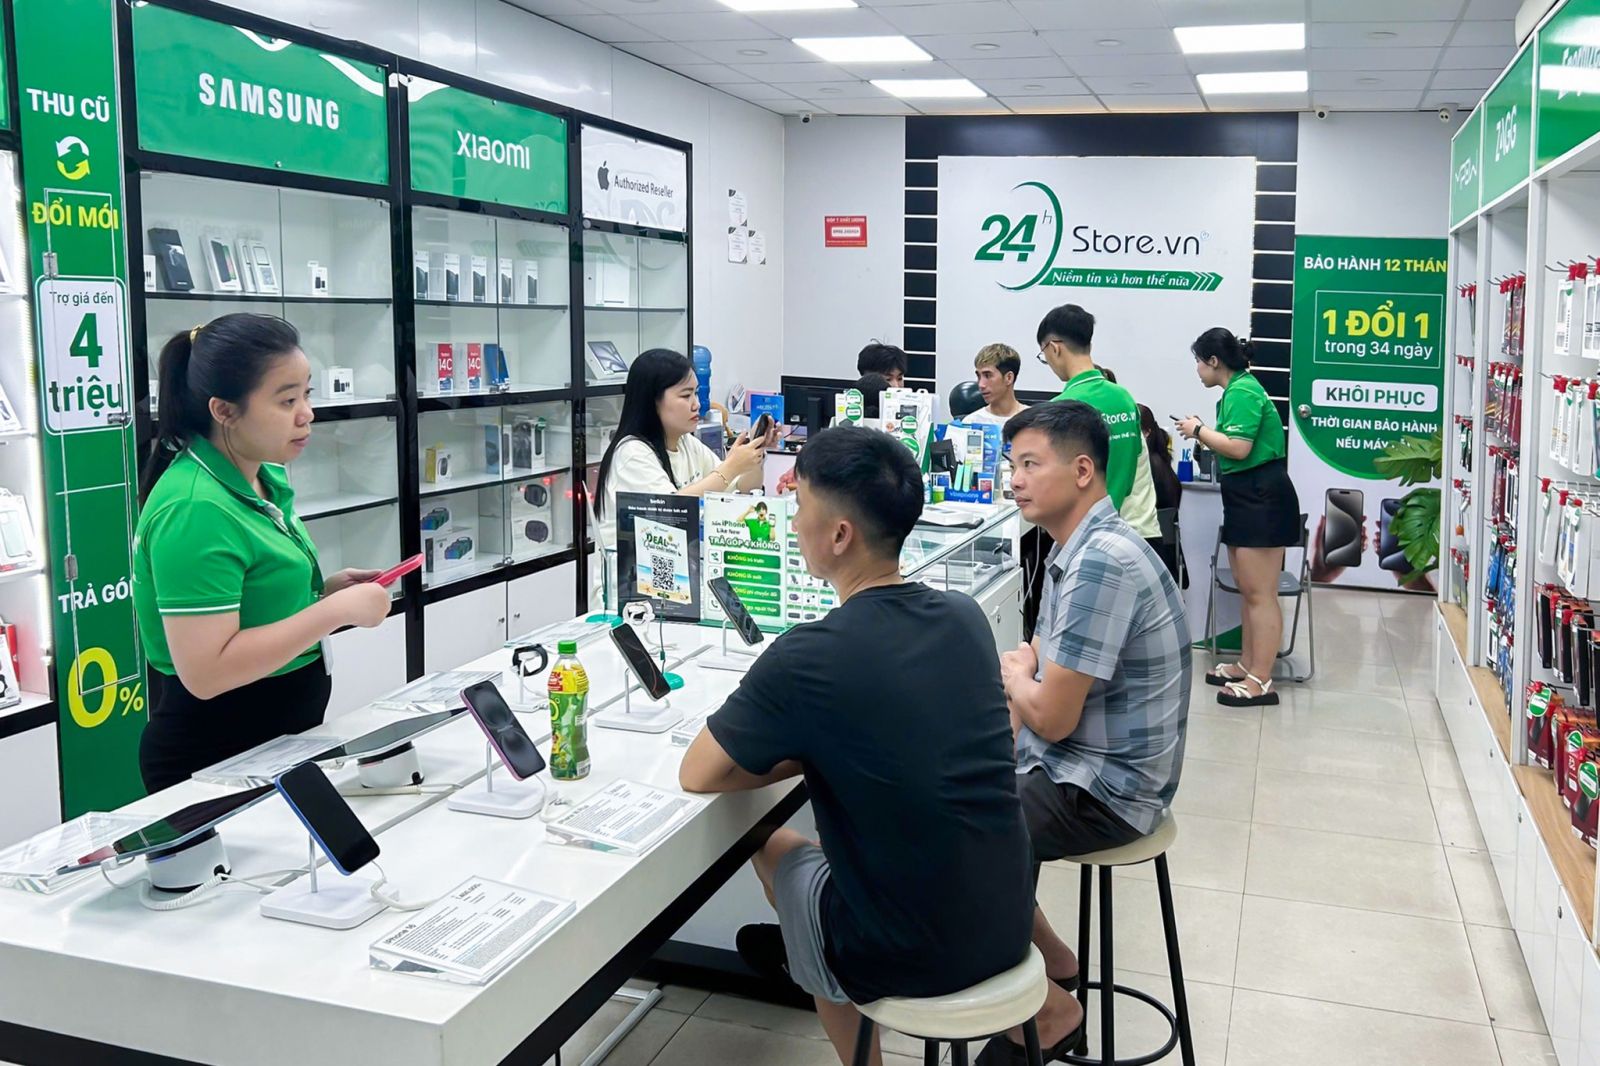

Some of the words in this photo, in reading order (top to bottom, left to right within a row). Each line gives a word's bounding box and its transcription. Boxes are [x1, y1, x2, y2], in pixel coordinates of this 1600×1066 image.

[26, 88, 74, 117] THU
[81, 95, 110, 122] CŨ
[199, 73, 339, 130] SAMSUNG
[614, 175, 649, 194] Authorized
[650, 182, 674, 199] Reseller
[32, 197, 72, 226] ĐỔI
[78, 203, 119, 230] MỚI
[1072, 226, 1200, 256] Store.vn
[1304, 254, 1334, 270] BẢO
[1337, 255, 1381, 271] HÀNH
[1384, 259, 1400, 271] 12
[1052, 269, 1082, 286] Niềm
[1086, 271, 1100, 284] tin
[1105, 272, 1118, 284] và
[1122, 273, 1143, 285] hơn
[1147, 272, 1168, 285] thế
[1168, 274, 1190, 287] nữa
[72, 292, 90, 306] giá
[92, 290, 114, 304] đến
[1322, 309, 1337, 335] 1
[1345, 300, 1406, 338] ĐỔI
[1414, 312, 1429, 338] 1
[69, 312, 103, 368] 4
[1324, 340, 1366, 357] trong
[1369, 341, 1390, 355] 34
[1394, 343, 1433, 360] ngày
[438, 358, 453, 371] 14C
[468, 356, 481, 370] 14C
[49, 375, 122, 417] triệu
[1326, 385, 1369, 403] KHÔI
[1374, 389, 1426, 408] PHỤC
[1311, 415, 1340, 428] THỜI
[1342, 417, 1372, 430] GIAN
[1374, 416, 1399, 431] BẢO
[1402, 418, 1438, 433] HÀNH
[1336, 435, 1361, 449] NẾU
[58, 583, 98, 613] TRẢ
